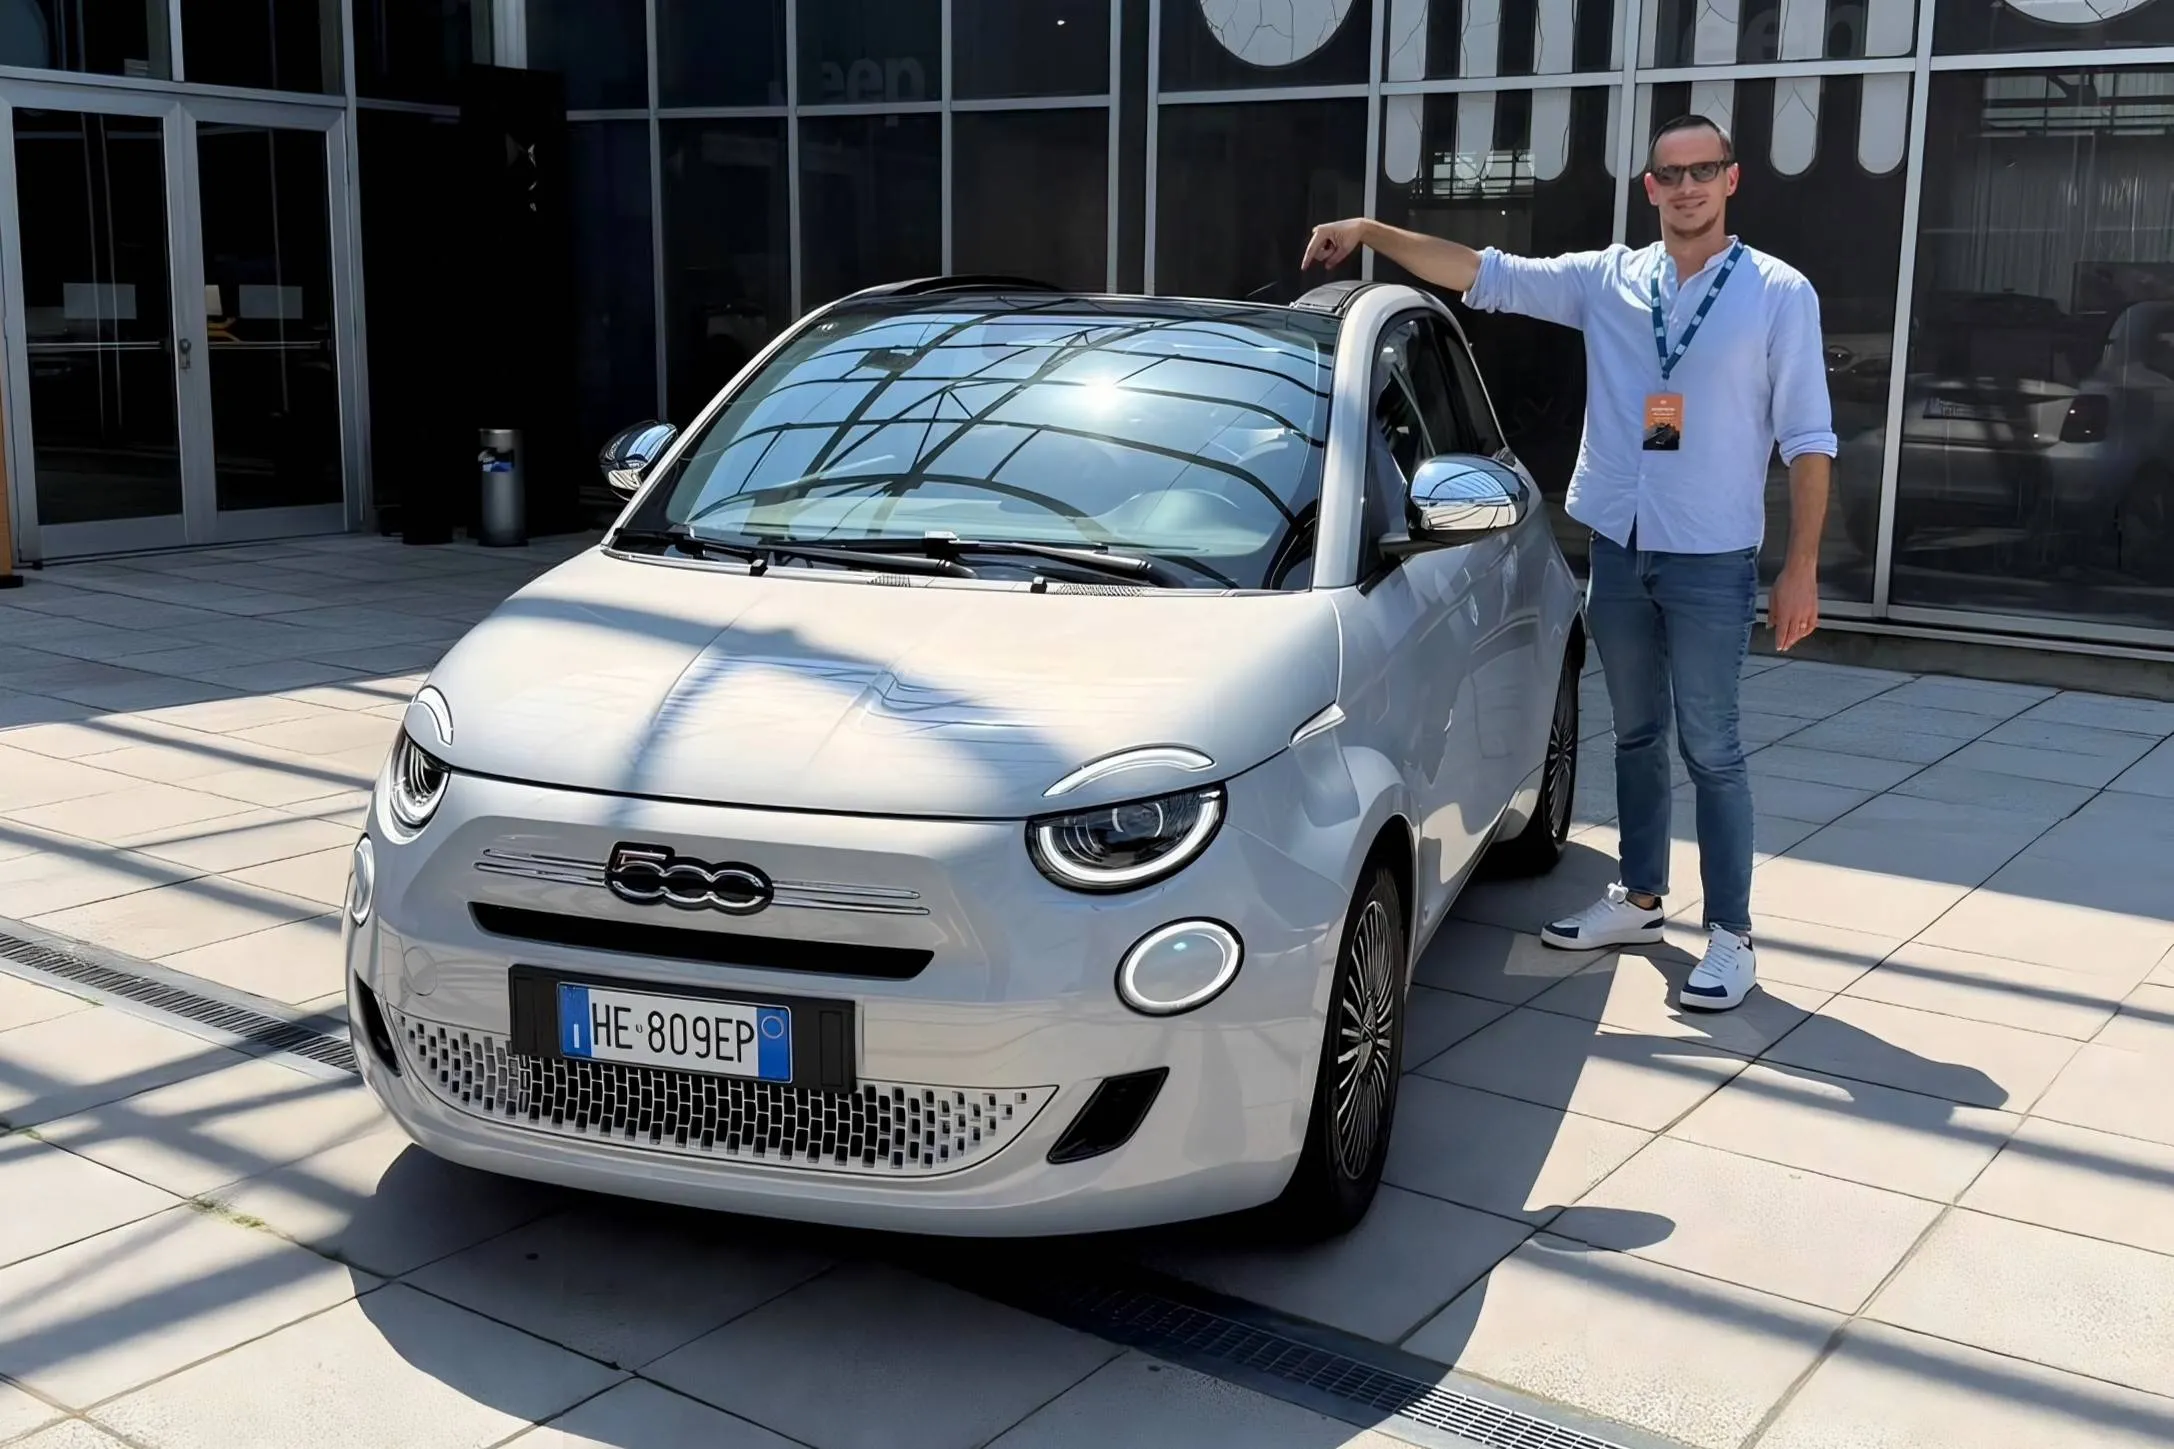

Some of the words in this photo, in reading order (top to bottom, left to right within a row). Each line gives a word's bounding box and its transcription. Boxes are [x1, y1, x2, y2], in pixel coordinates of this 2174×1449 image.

[611, 848, 768, 909] 500
[592, 1002, 633, 1049] HE
[647, 1011, 755, 1063] 809EP
